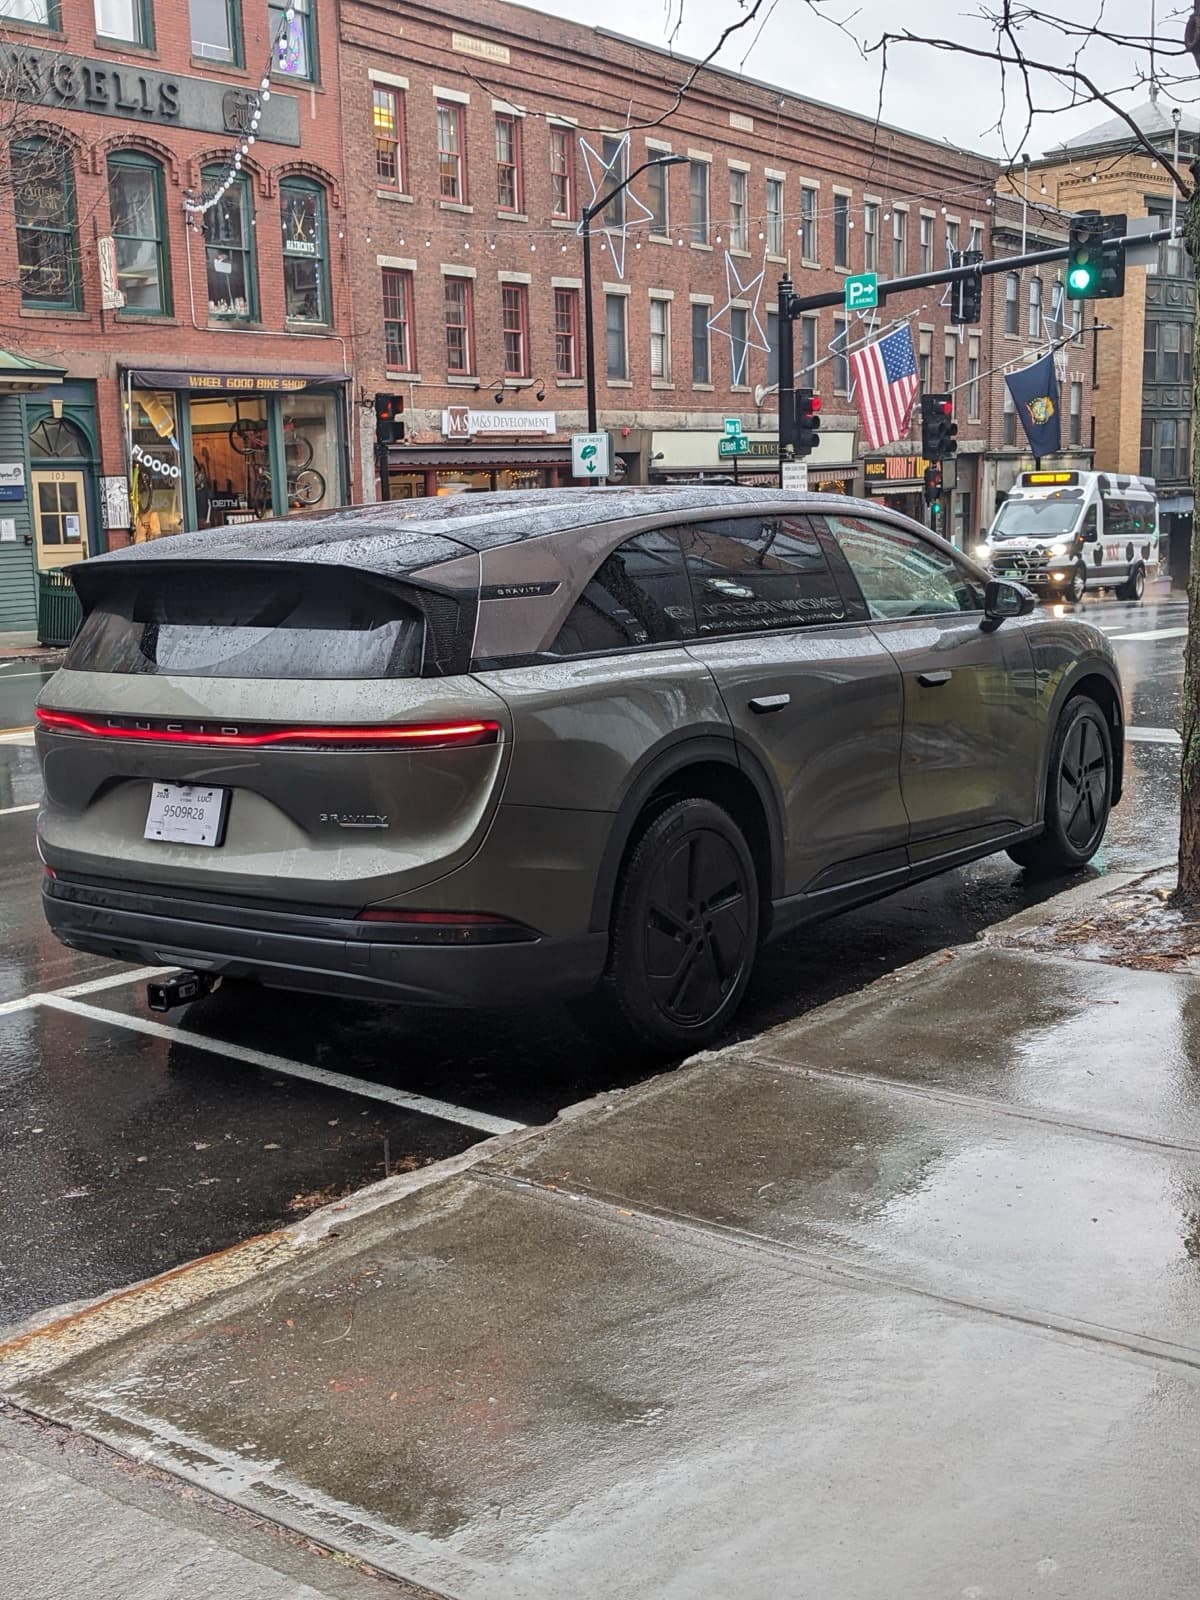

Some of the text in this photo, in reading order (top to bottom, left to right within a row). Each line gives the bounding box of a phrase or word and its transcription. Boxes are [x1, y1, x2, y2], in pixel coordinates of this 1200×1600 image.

[286, 239, 315, 253] HAIRCUTS
[189, 376, 307, 390] WHEEL GOOD BIKE SHOP
[471, 415, 491, 429] M&S
[721, 440, 747, 451] Elliot St
[866, 463, 885, 474] MUSIC
[885, 457, 907, 479] TURN
[497, 586, 541, 596] GRAVITY
[107, 718, 239, 736] LUCID
[163, 804, 205, 821] 9509R28
[319, 813, 388, 824] GRAVITY
